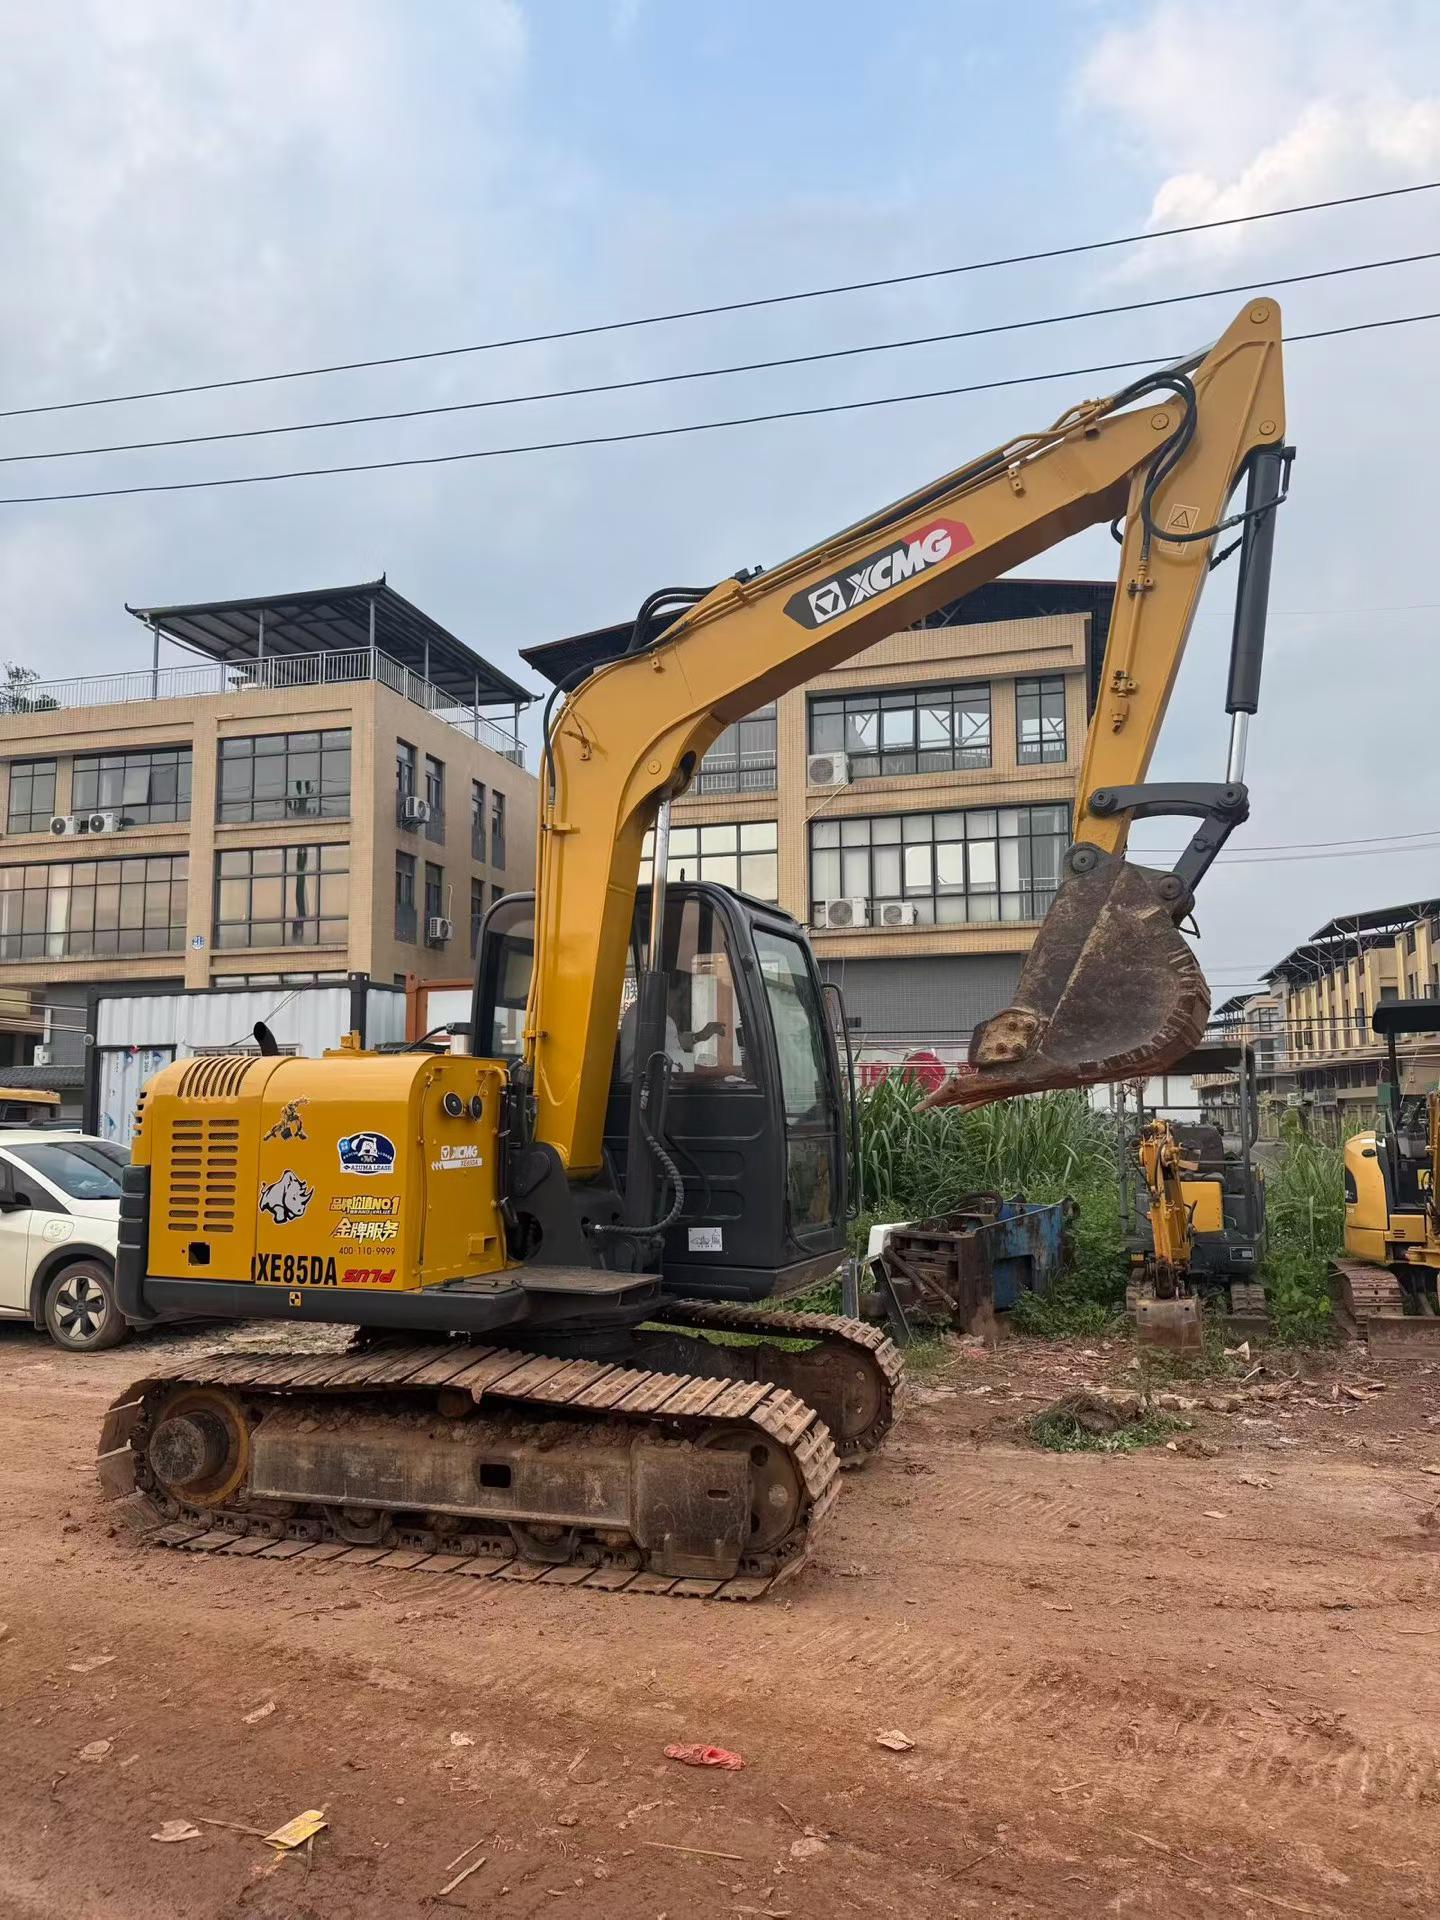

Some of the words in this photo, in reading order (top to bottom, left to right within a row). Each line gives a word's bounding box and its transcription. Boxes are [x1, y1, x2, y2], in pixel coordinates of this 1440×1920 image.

[846, 529, 952, 607] XCMG
[331, 1217, 399, 1243] 金牌服务
[342, 1269, 396, 1283] PLUS
